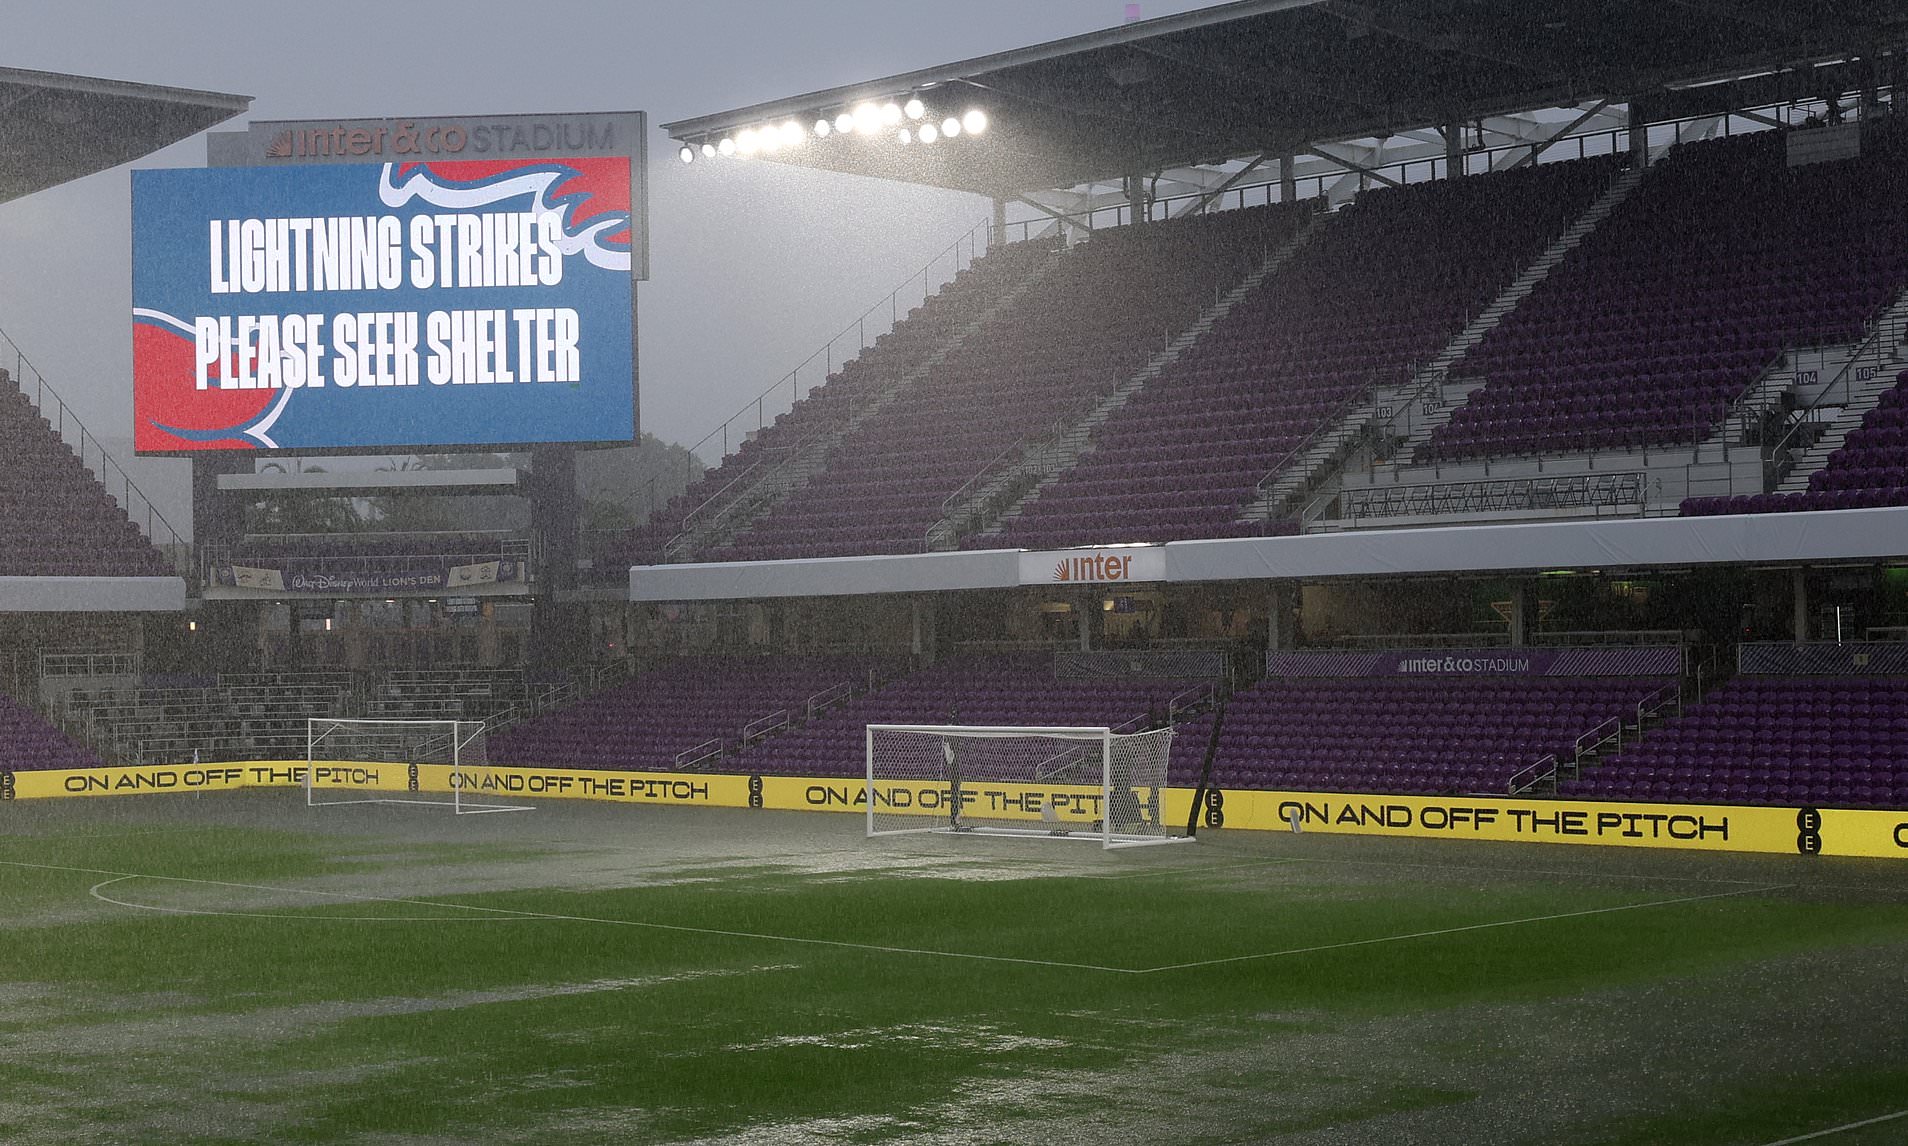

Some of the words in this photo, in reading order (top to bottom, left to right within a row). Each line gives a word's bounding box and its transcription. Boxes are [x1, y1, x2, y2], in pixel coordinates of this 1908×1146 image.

[472, 122, 614, 153] STADIUM
[209, 215, 401, 294] LIGHTNING
[410, 212, 563, 290] STRIKES
[195, 313, 326, 390] PLEASE
[332, 311, 419, 387] SEEK
[426, 308, 580, 385] SHELTER
[1798, 372, 1816, 384] 104
[1857, 367, 1876, 379] 105
[1377, 407, 1391, 418] 103
[353, 577, 379, 587] World
[382, 576, 416, 586] LION'S
[419, 575, 441, 585] DEN
[1073, 553, 1132, 581] inter
[1473, 658, 1529, 672] STADIUM
[64, 775, 109, 792] ON
[114, 771, 178, 790] AND
[183, 769, 243, 786] OFF
[249, 767, 310, 783] THE
[316, 767, 379, 785] PITCH
[448, 772, 478, 790] ON
[481, 773, 524, 791] AND
[528, 775, 573, 793] OFF
[578, 777, 626, 796] THE
[630, 779, 708, 800] PITCH
[805, 785, 848, 806] ON
[853, 787, 912, 808] AND
[918, 788, 979, 810] OFF
[984, 791, 1044, 813] THE
[1278, 801, 1329, 824] ON
[1336, 803, 1412, 828] AND
[1420, 806, 1499, 831] OFF
[1506, 809, 1588, 835] THE
[1597, 812, 1728, 841] PITCH
